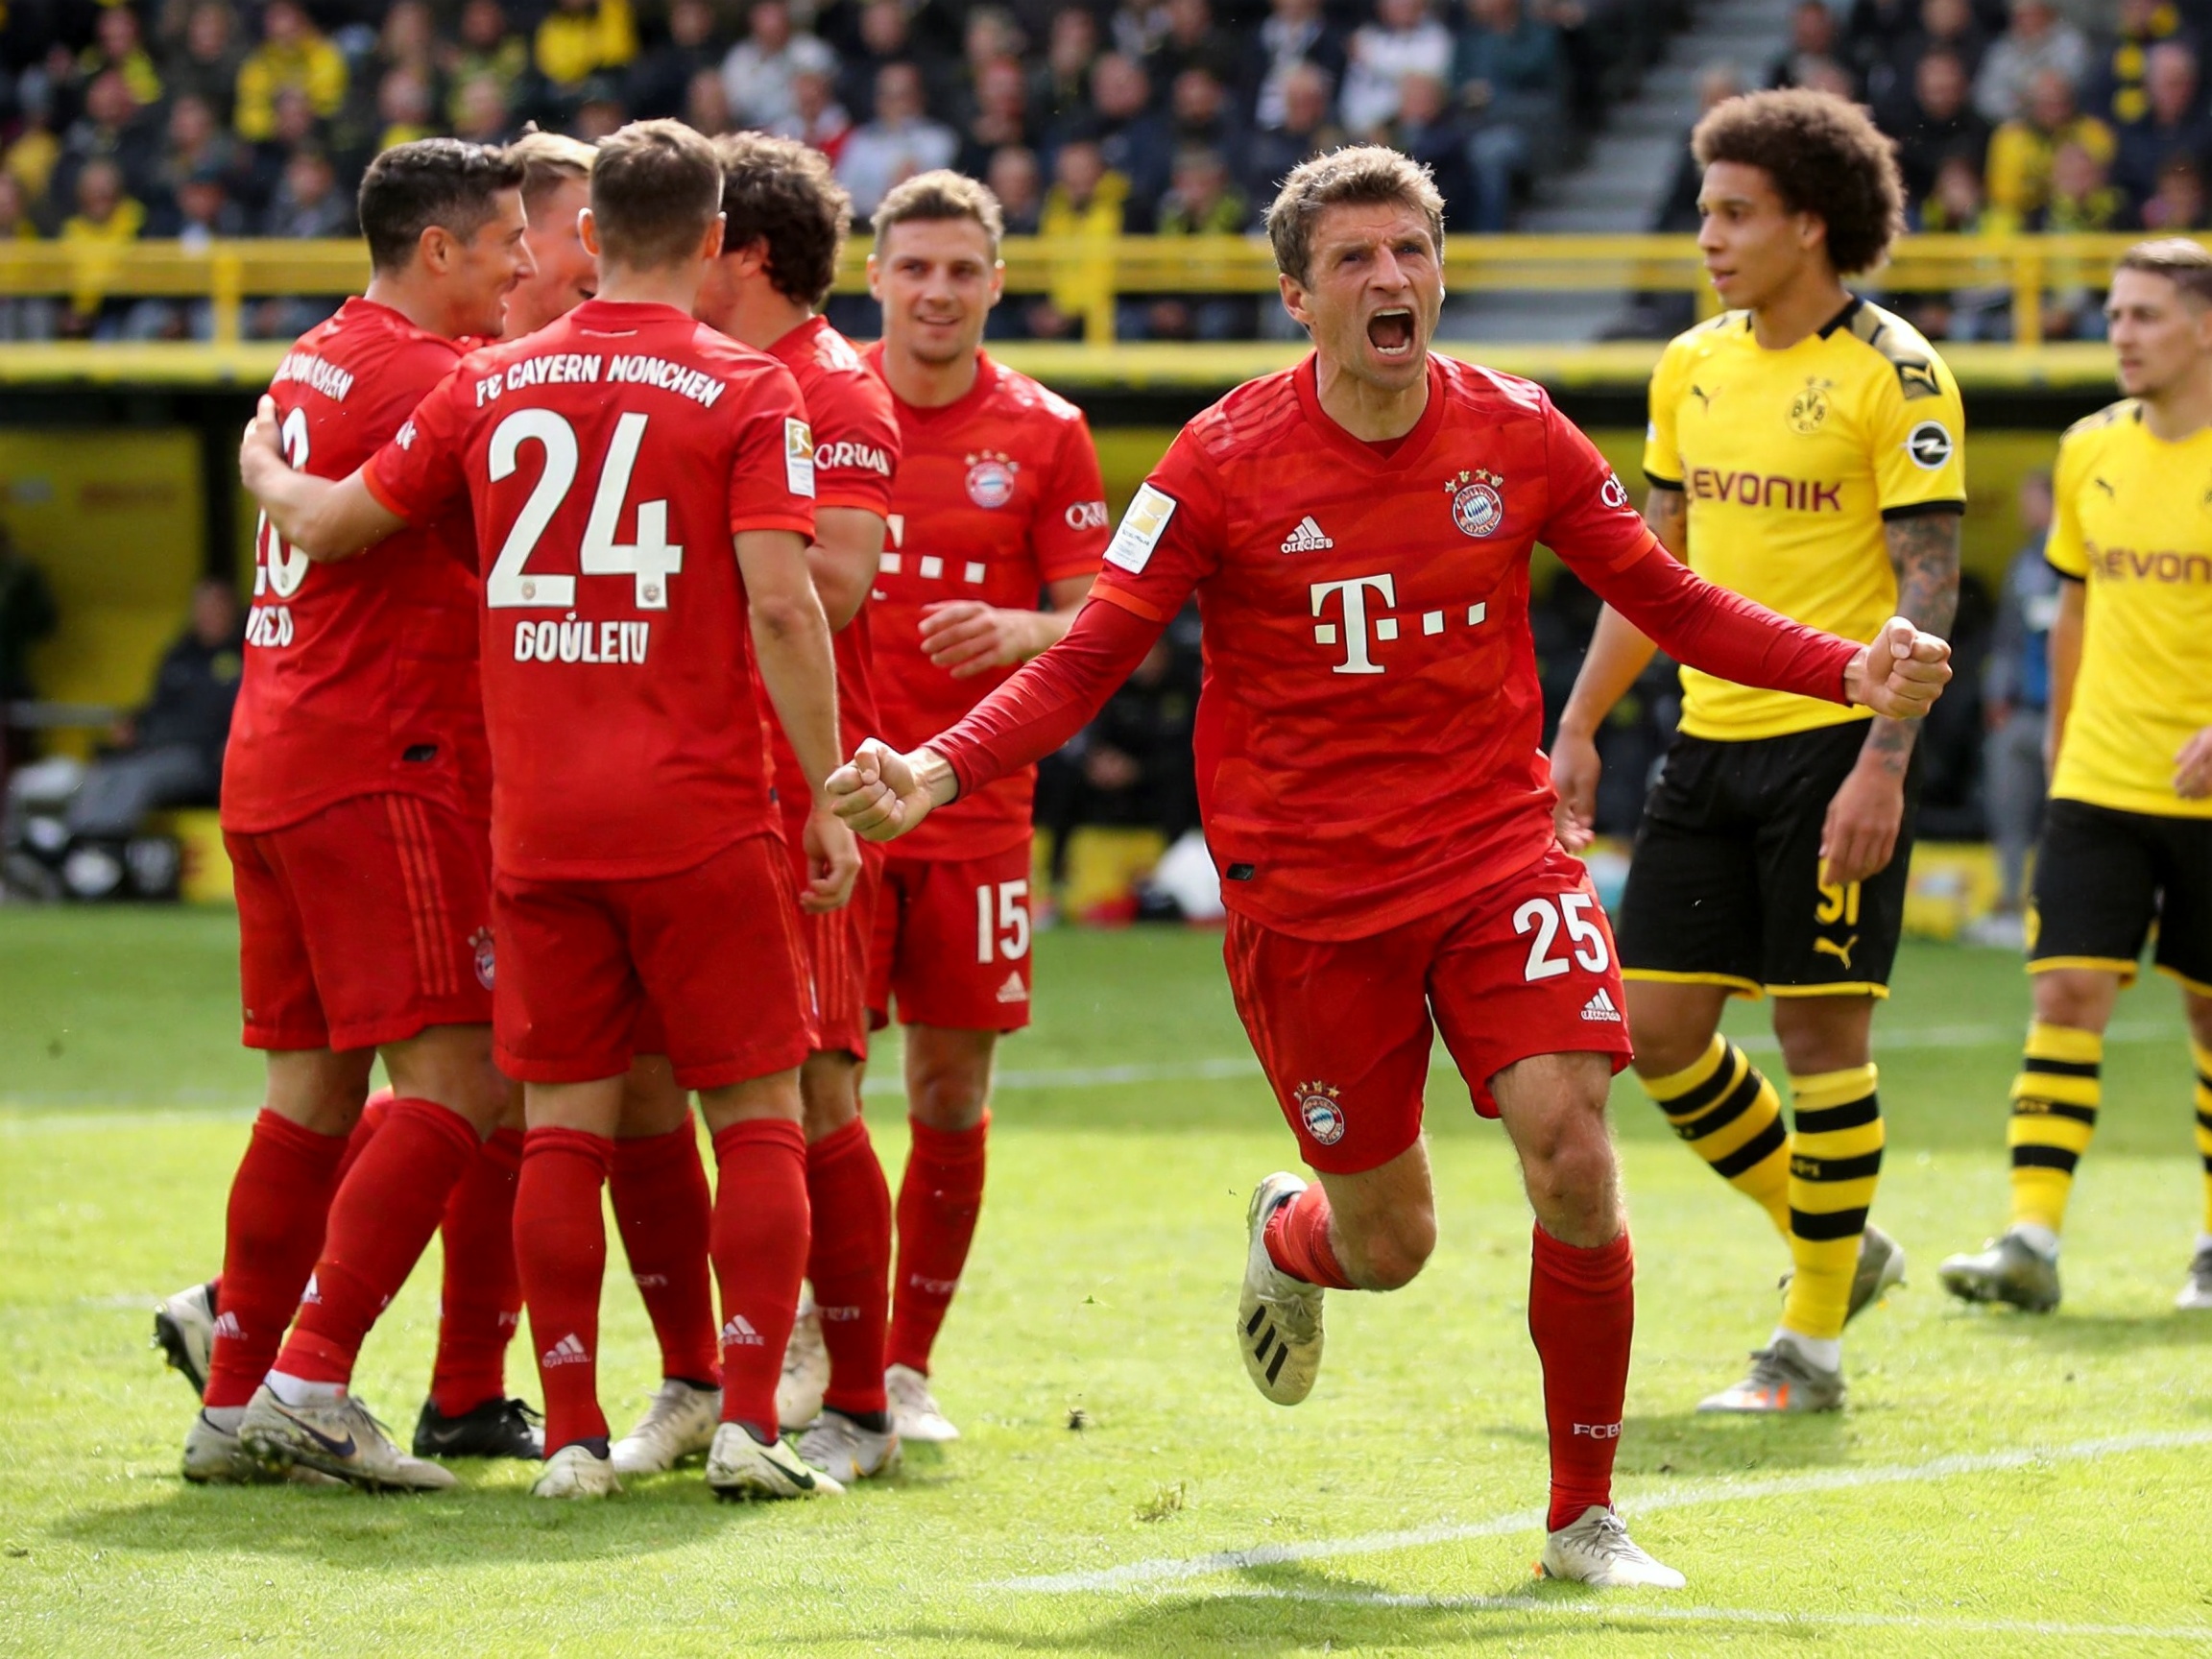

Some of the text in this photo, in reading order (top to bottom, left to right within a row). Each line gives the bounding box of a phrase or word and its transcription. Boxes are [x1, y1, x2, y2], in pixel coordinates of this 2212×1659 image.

[487, 408, 684, 610] 24
[1694, 469, 1842, 513] EVONIK
[976, 878, 1030, 964] 15
[1512, 893, 1609, 982] 25
